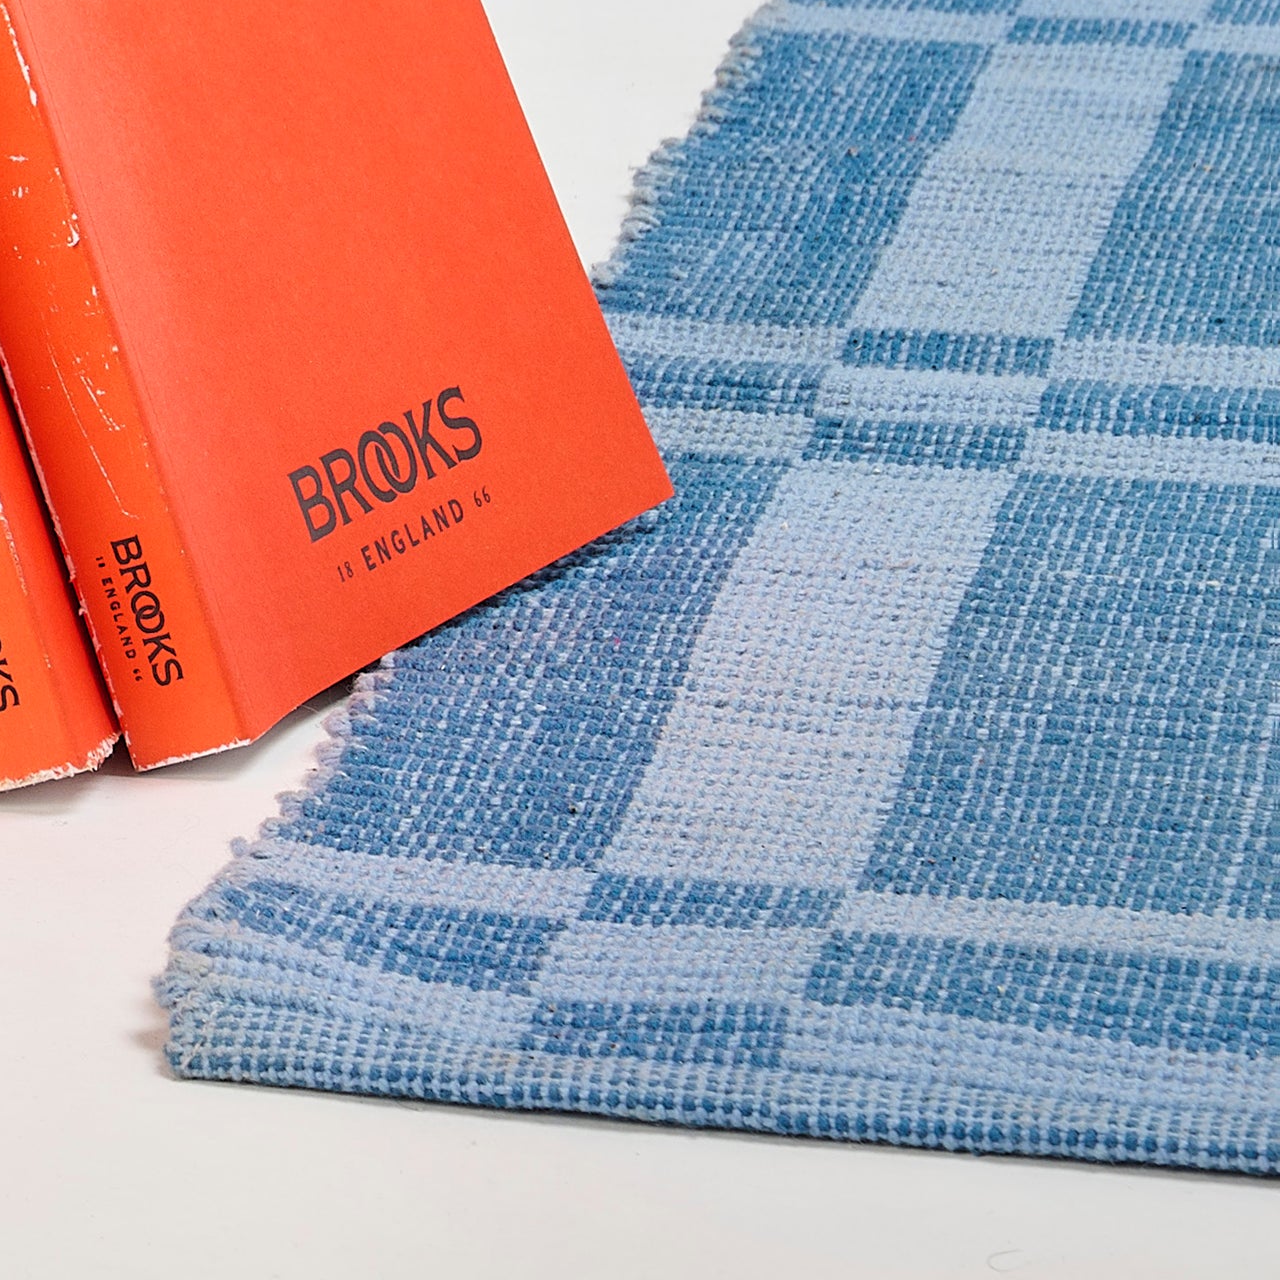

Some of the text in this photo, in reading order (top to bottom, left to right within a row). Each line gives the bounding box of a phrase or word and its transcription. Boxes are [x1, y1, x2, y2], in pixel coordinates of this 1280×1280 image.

[286, 385, 483, 544] BROOKS
[337, 486, 492, 583] 18 ENGLAND 66
[101, 577, 137, 660] ENGLAND
[110, 534, 184, 687] BROOKS
